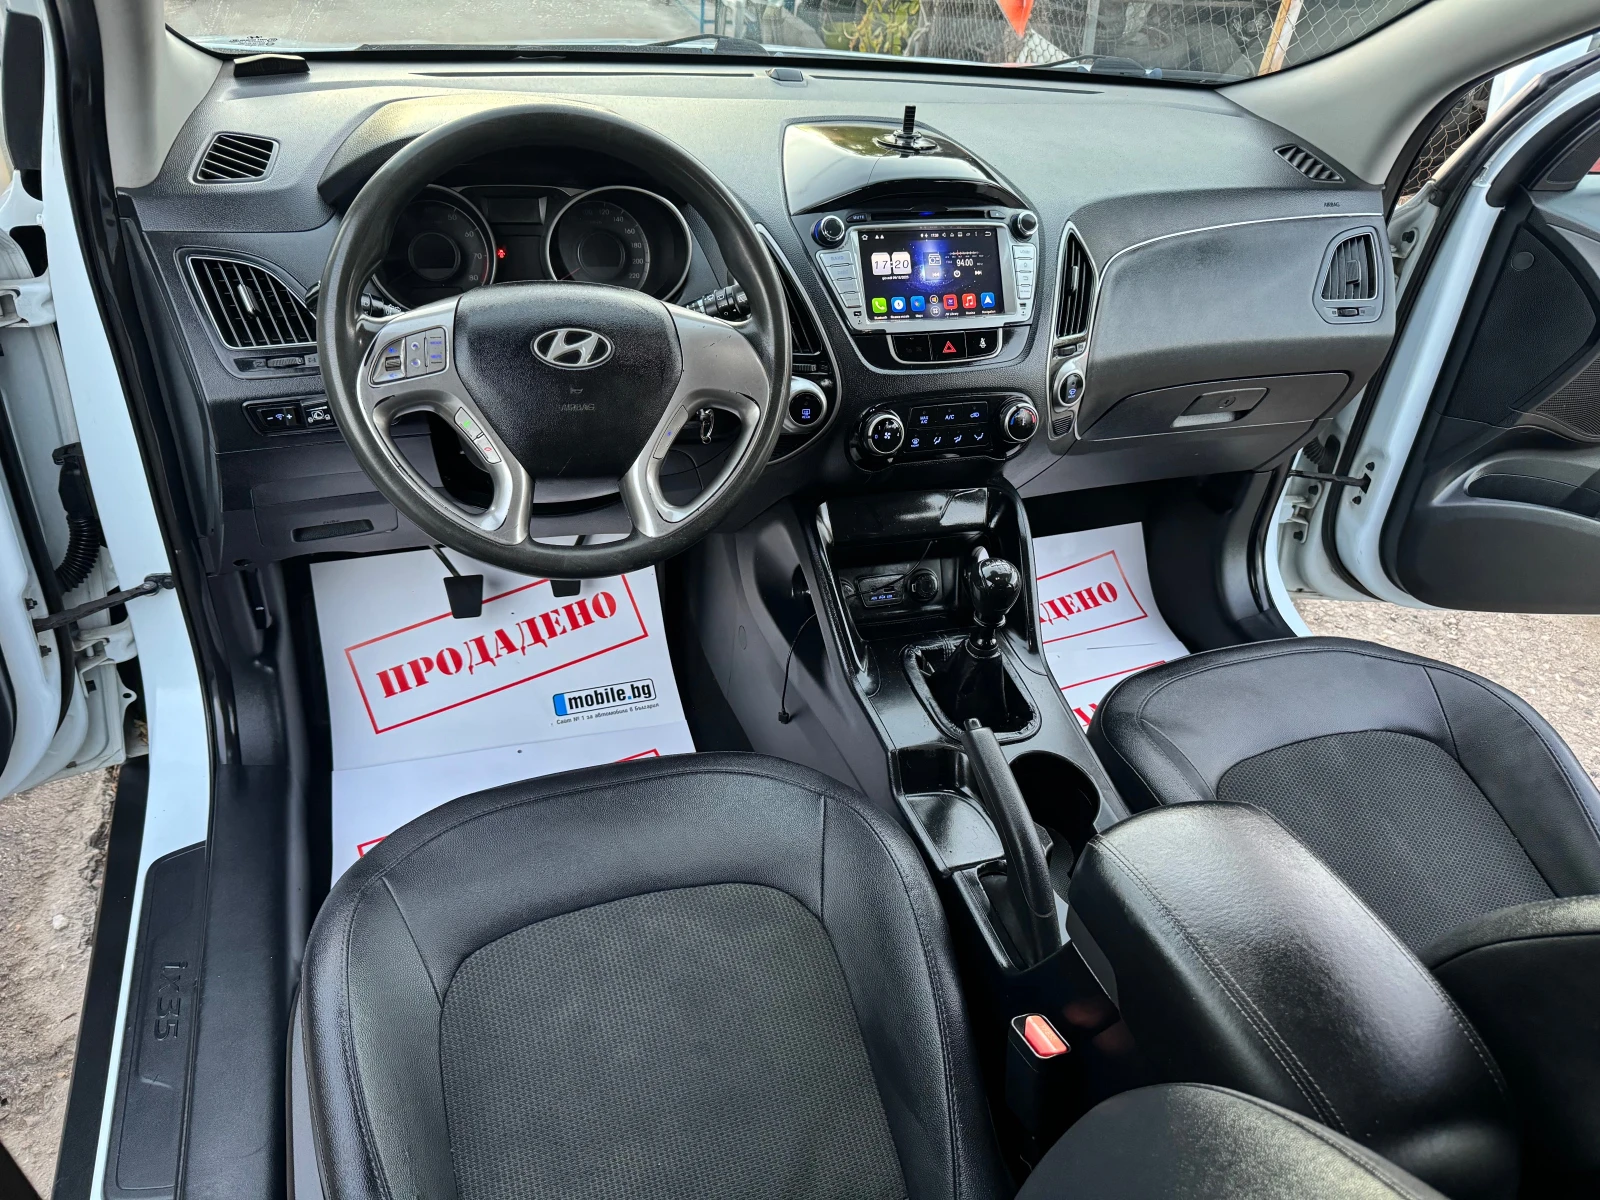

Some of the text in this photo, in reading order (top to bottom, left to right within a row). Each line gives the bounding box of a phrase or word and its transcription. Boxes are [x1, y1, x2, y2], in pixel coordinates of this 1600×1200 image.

[1040, 581, 1118, 626] ДЕНО
[375, 590, 618, 699] ПРОДАДЕНО
[568, 683, 652, 710] mobile.bg
[153, 961, 188, 1041] ix35
